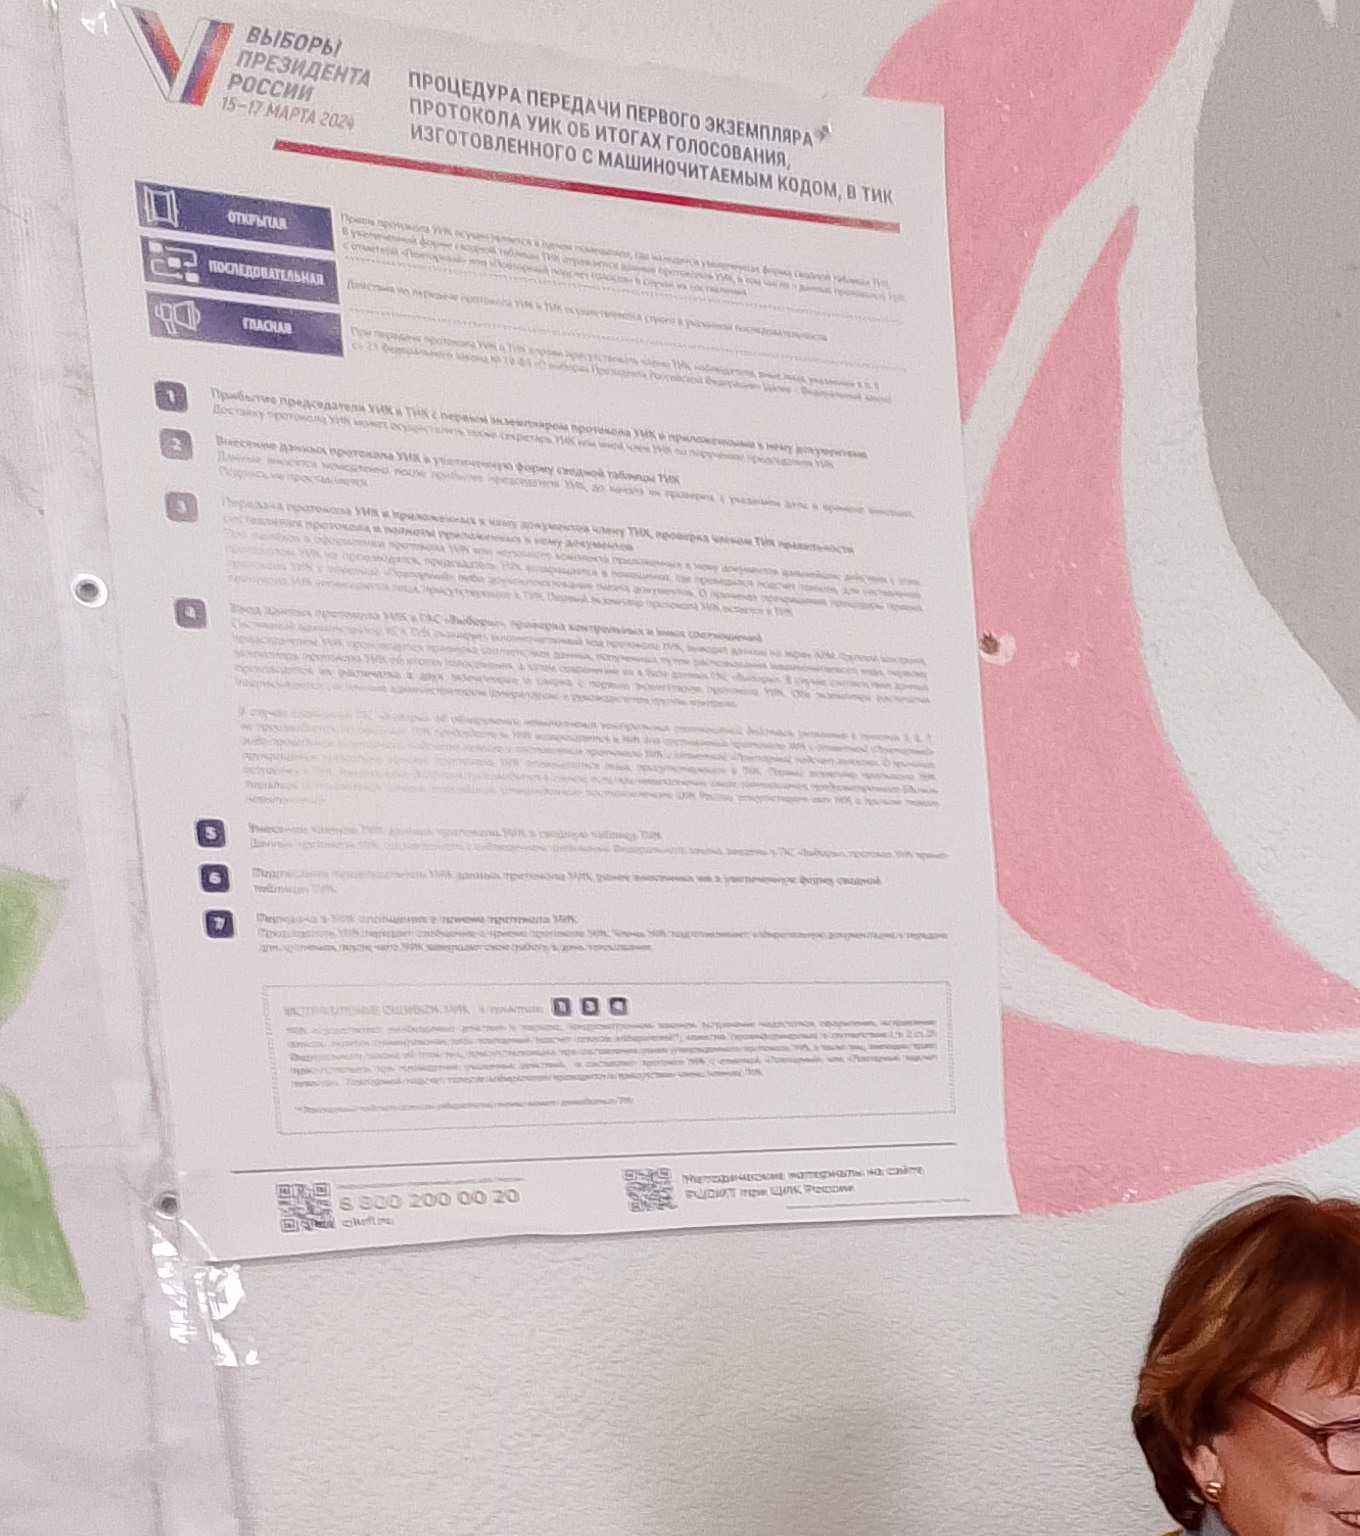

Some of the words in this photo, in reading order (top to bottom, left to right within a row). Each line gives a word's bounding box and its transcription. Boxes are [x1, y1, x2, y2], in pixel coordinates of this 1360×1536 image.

[246, 26, 342, 58] ВЫБОРЫ
[235, 50, 371, 87] ПРЕЗИДЕНТА
[227, 73, 314, 102] РОССИИ
[408, 70, 522, 105] ПРОЦЕДУРА
[526, 89, 621, 119] ПЕРЕДАЧИ
[626, 103, 700, 130] ПЕРВОГО
[266, 102, 315, 125] МАРТА
[319, 111, 355, 131] 2024
[409, 98, 522, 130] ПРОТОКОЛА
[527, 112, 561, 136] УИК
[567, 120, 591, 139] ОБ
[595, 123, 661, 150] ИТОГАХ
[666, 134, 792, 170] ГОЛОСОВАНИЯ,
[410, 123, 577, 163] ИЗГОТОВЛЕННОГО
[582, 148, 593, 165] С
[598, 151, 773, 190] МАШИНОЧИТАЕМЫМ
[778, 174, 843, 201] КОДОМ,
[846, 183, 857, 200] В
[861, 185, 895, 206] ТИК
[226, 209, 288, 230] ОТКРЫТАЯ
[208, 259, 325, 286] ПОСЛЕДОВАТЕЛЬНАЯ
[242, 316, 293, 335] ГЛАСНАЯ
[409, 1191, 451, 1208] 200
[457, 1189, 487, 1206] 00
[493, 1188, 520, 1204] 20
